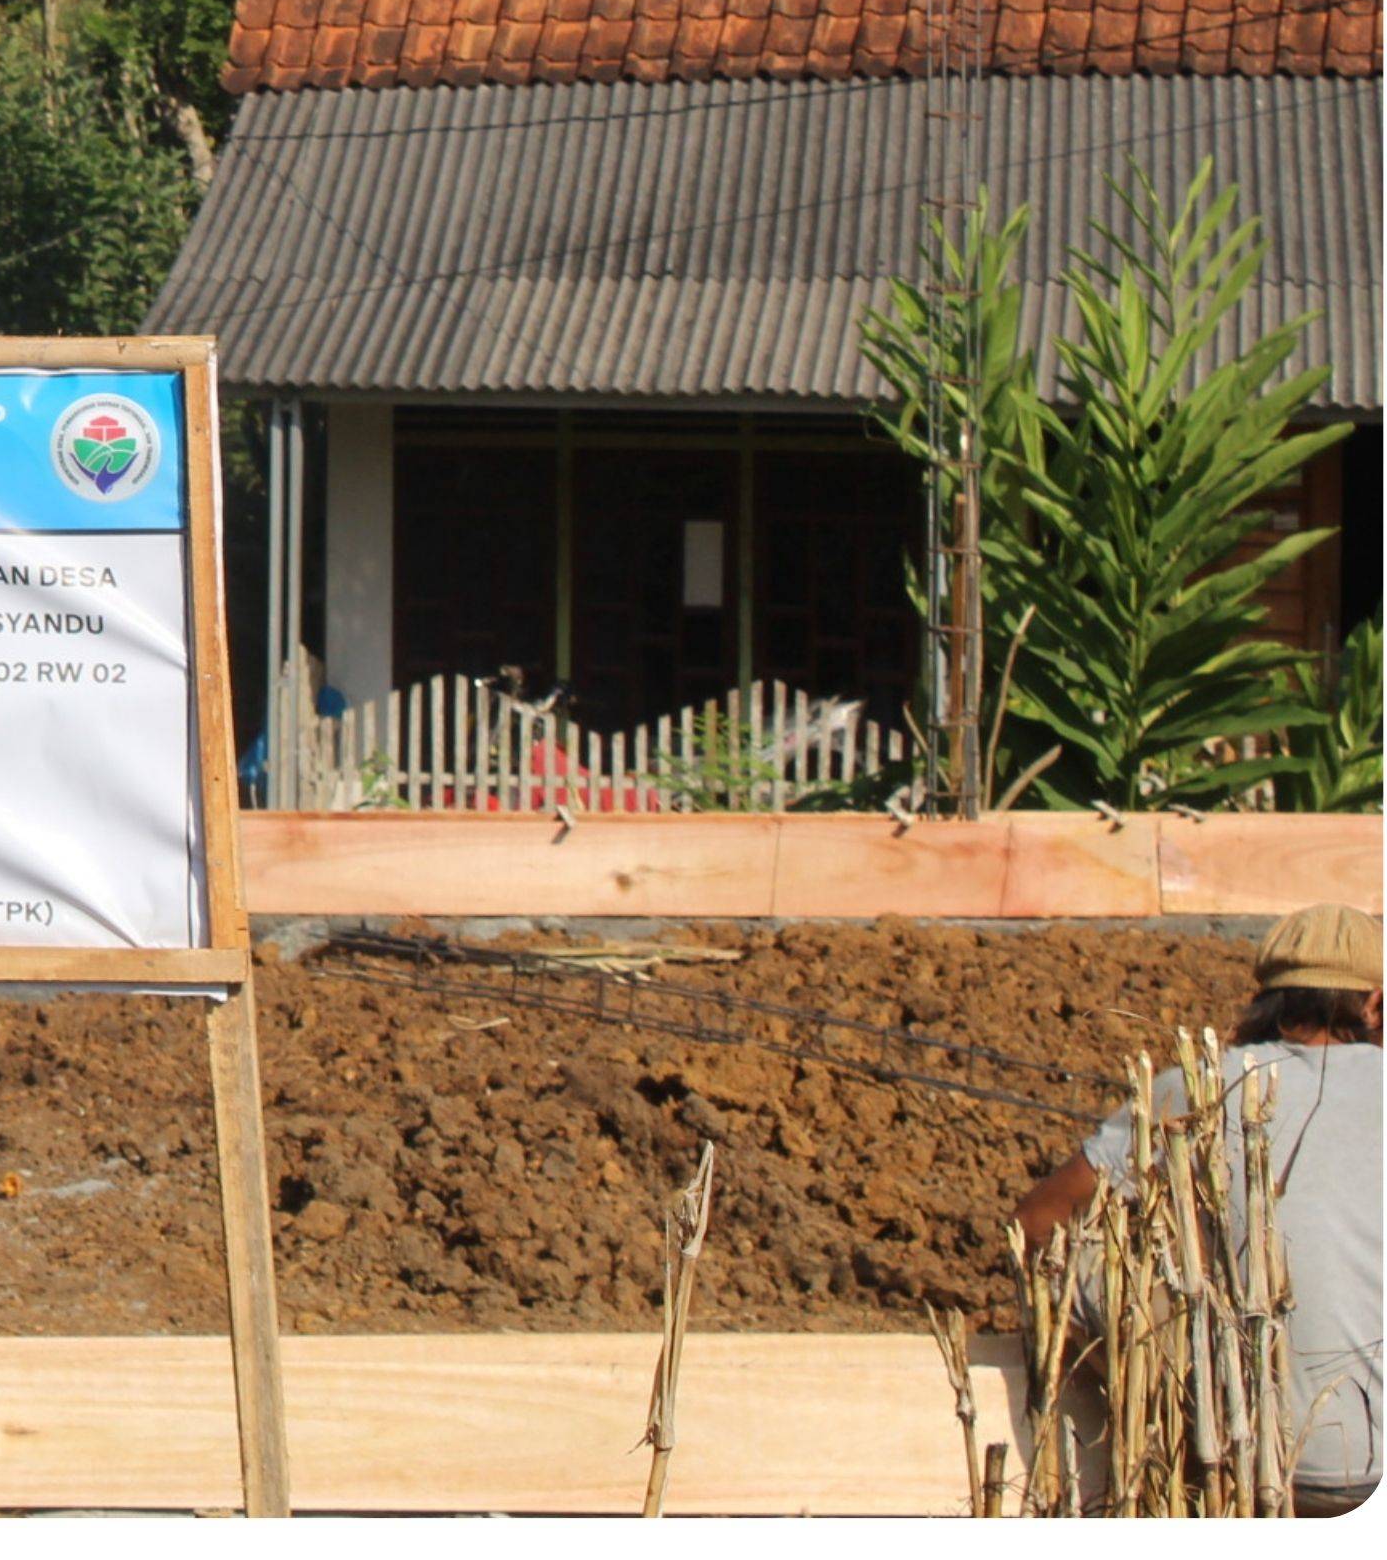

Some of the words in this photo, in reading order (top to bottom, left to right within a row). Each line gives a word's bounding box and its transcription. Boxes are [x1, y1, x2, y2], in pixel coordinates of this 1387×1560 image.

[40, 565, 118, 588] DESA
[37, 662, 83, 683] RW
[93, 663, 126, 684] 02
